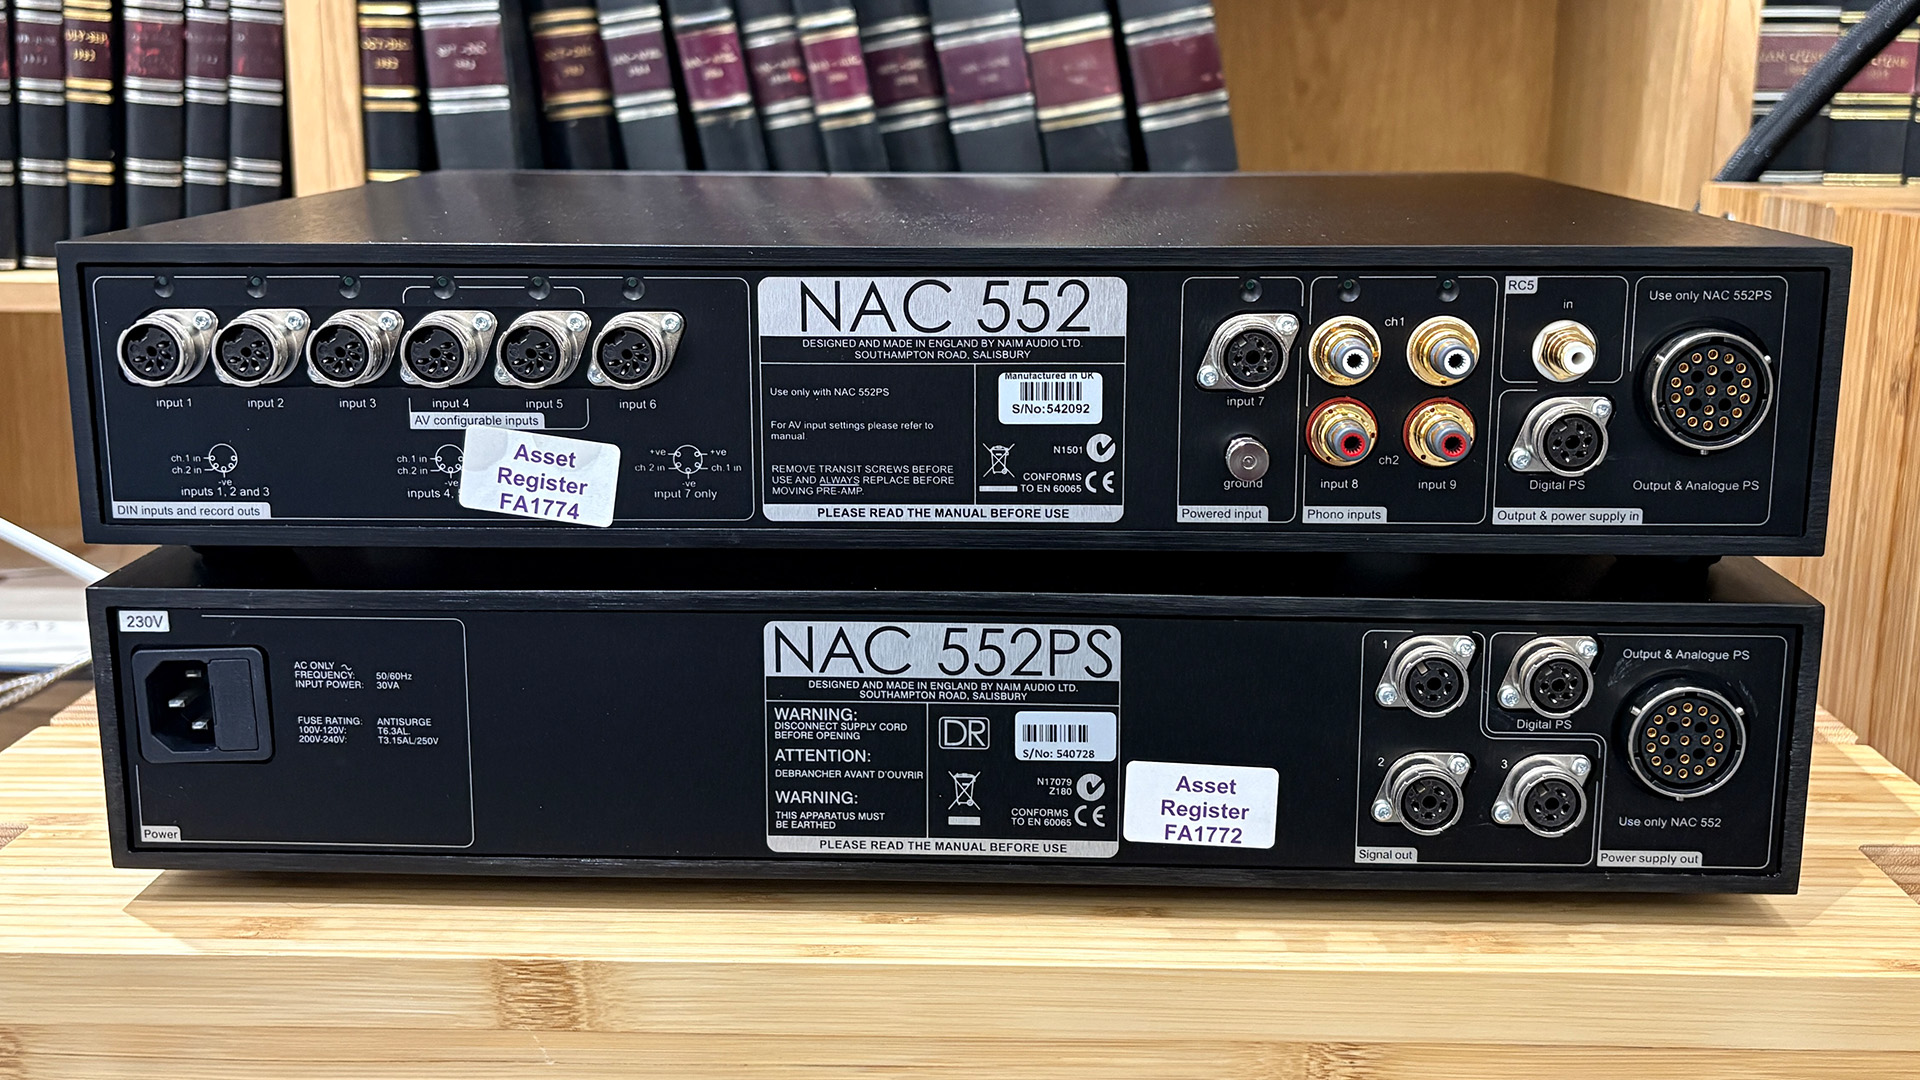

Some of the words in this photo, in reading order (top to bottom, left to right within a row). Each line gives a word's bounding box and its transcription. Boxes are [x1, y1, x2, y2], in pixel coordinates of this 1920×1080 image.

[1509, 280, 1534, 290] RC5
[1650, 291, 1672, 301] Use
[1676, 291, 1700, 302] only
[1703, 290, 1730, 300] NAC
[1734, 290, 1772, 301] 552PS
[801, 279, 952, 333] NAC
[977, 279, 1090, 333] 552
[1563, 299, 1574, 309] in
[1385, 317, 1404, 327] ch1
[803, 339, 856, 348] DESIGNED
[859, 340, 880, 348] AND
[883, 339, 912, 348] MADE
[916, 340, 926, 348] IN
[929, 339, 978, 348] ENGLAND
[981, 339, 995, 348] BY
[998, 339, 1023, 347] NAIM
[1026, 339, 1059, 348] AUDIO
[1062, 339, 1083, 348] LTD.
[855, 351, 934, 359] SOUTHAMPTON
[973, 350, 1031, 359] SALISBURY
[770, 388, 788, 396] Use
[791, 388, 810, 398] only
[813, 388, 831, 396] with
[834, 388, 856, 396] NAC
[859, 388, 890, 397] 552PS
[157, 399, 183, 409] input
[248, 399, 274, 410] input
[278, 398, 284, 408] 2
[340, 399, 366, 410] input
[370, 398, 376, 408] 3
[433, 400, 460, 410] input
[463, 399, 469, 408] 4
[526, 400, 553, 410] input
[557, 399, 563, 408] 5
[620, 400, 646, 411] input
[650, 399, 657, 409] 6
[1227, 397, 1254, 408] input
[1258, 396, 1265, 406] 7
[415, 415, 430, 425] AV
[434, 415, 502, 428] configurable
[505, 416, 539, 427] inputs
[1054, 446, 1082, 454] N1501
[514, 444, 576, 468] Asset
[1379, 455, 1399, 465] ch2
[498, 467, 588, 495] Register
[1023, 473, 1082, 481] CONFORMS
[1021, 484, 1034, 493] TO
[1037, 484, 1050, 493] EN
[1053, 485, 1082, 493] 60065
[1224, 478, 1263, 490] ground
[1321, 479, 1348, 491] input
[1352, 479, 1358, 489] 8
[1418, 481, 1446, 491] input
[1450, 480, 1456, 489] 9
[1530, 480, 1565, 491] Digital
[1569, 480, 1585, 490] PS
[1633, 480, 1671, 492] Output
[1675, 480, 1682, 490] &
[1685, 481, 1739, 492] Analogue
[1743, 481, 1759, 490] PS
[118, 505, 138, 515] DIN
[142, 506, 174, 517] inputs
[177, 506, 196, 516] and
[200, 506, 234, 516] record
[238, 507, 260, 516] outs
[500, 493, 580, 520] FA1774
[818, 508, 866, 518] PLEASE
[870, 508, 904, 518] READ
[907, 508, 931, 518] THE
[935, 508, 987, 518] MANUAL
[991, 509, 1041, 518] BEFORE
[1045, 509, 1069, 518] USE
[1182, 509, 1231, 519] Powered
[1235, 509, 1262, 521] input
[1308, 509, 1344, 520] Phono
[1348, 510, 1381, 522] inputs
[1498, 510, 1536, 523] Output
[1540, 511, 1547, 521] &
[1551, 513, 1587, 523] power
[1590, 511, 1626, 523] supply
[1630, 511, 1639, 521] in
[127, 615, 163, 628] 230V
[775, 626, 912, 675] NAC
[938, 626, 1112, 678] 552PS
[1622, 649, 1661, 662] Output
[1664, 649, 1673, 659] &
[1675, 650, 1729, 662] Analogue
[1733, 650, 1750, 660] PS
[294, 661, 308, 669] AC
[310, 661, 334, 670] ONLY
[295, 671, 355, 679] FREQUENCY:
[376, 672, 412, 680] 50/60Hz
[296, 680, 324, 688] INPUT
[326, 680, 364, 689] POWER:
[774, 707, 857, 722] WARNING:
[298, 716, 323, 725] FUSE
[325, 717, 363, 726] RATING:
[377, 718, 432, 726] ANTISURGE
[775, 722, 838, 730] DISCONNECT
[841, 722, 877, 731] SUPPLY
[879, 723, 908, 731] CORD
[1517, 719, 1551, 732] Digital
[1555, 718, 1572, 730] PS
[300, 726, 347, 734] 100V-120V:
[775, 731, 814, 740] BEFORE
[816, 732, 860, 740] OPENING
[942, 720, 986, 747] DR
[299, 735, 347, 744] 200V-240V:
[378, 736, 439, 745] T3.15AL/250V
[775, 749, 870, 762] ATTENTION:
[1023, 749, 1053, 759] S/No:
[1057, 750, 1095, 759] 540728
[1378, 757, 1385, 767] 2
[1501, 759, 1508, 769] 3
[775, 769, 842, 778] DEBRANCHER
[844, 770, 875, 778] AVANT
[878, 771, 923, 779] D'OUVRIR
[1037, 778, 1072, 786] N17079
[1176, 776, 1237, 795] Asset
[1049, 787, 1072, 796] Z180
[775, 791, 858, 804] WARNING:
[776, 811, 798, 819] THIS
[800, 812, 856, 820] APPARATUS
[858, 812, 885, 821] MUST
[1161, 800, 1250, 821] Register
[776, 820, 788, 829] BE
[791, 821, 836, 829] EARTHED
[1619, 817, 1641, 826] Use
[1644, 818, 1667, 829] only
[1671, 817, 1698, 827] NAC
[1701, 818, 1722, 827] 552
[144, 828, 180, 839] Power
[1165, 824, 1242, 844] FA1772
[820, 840, 867, 849] PLEASE
[871, 841, 904, 850] READ
[908, 841, 931, 851] THE
[935, 842, 986, 851] MANUAL
[990, 843, 1039, 852] BEFORE
[1043, 844, 1067, 853] USE
[1359, 849, 1392, 861] Signal
[1395, 851, 1412, 860] out
[1601, 853, 1636, 863] Power
[1639, 854, 1677, 866] supply
[1680, 856, 1698, 864] out
